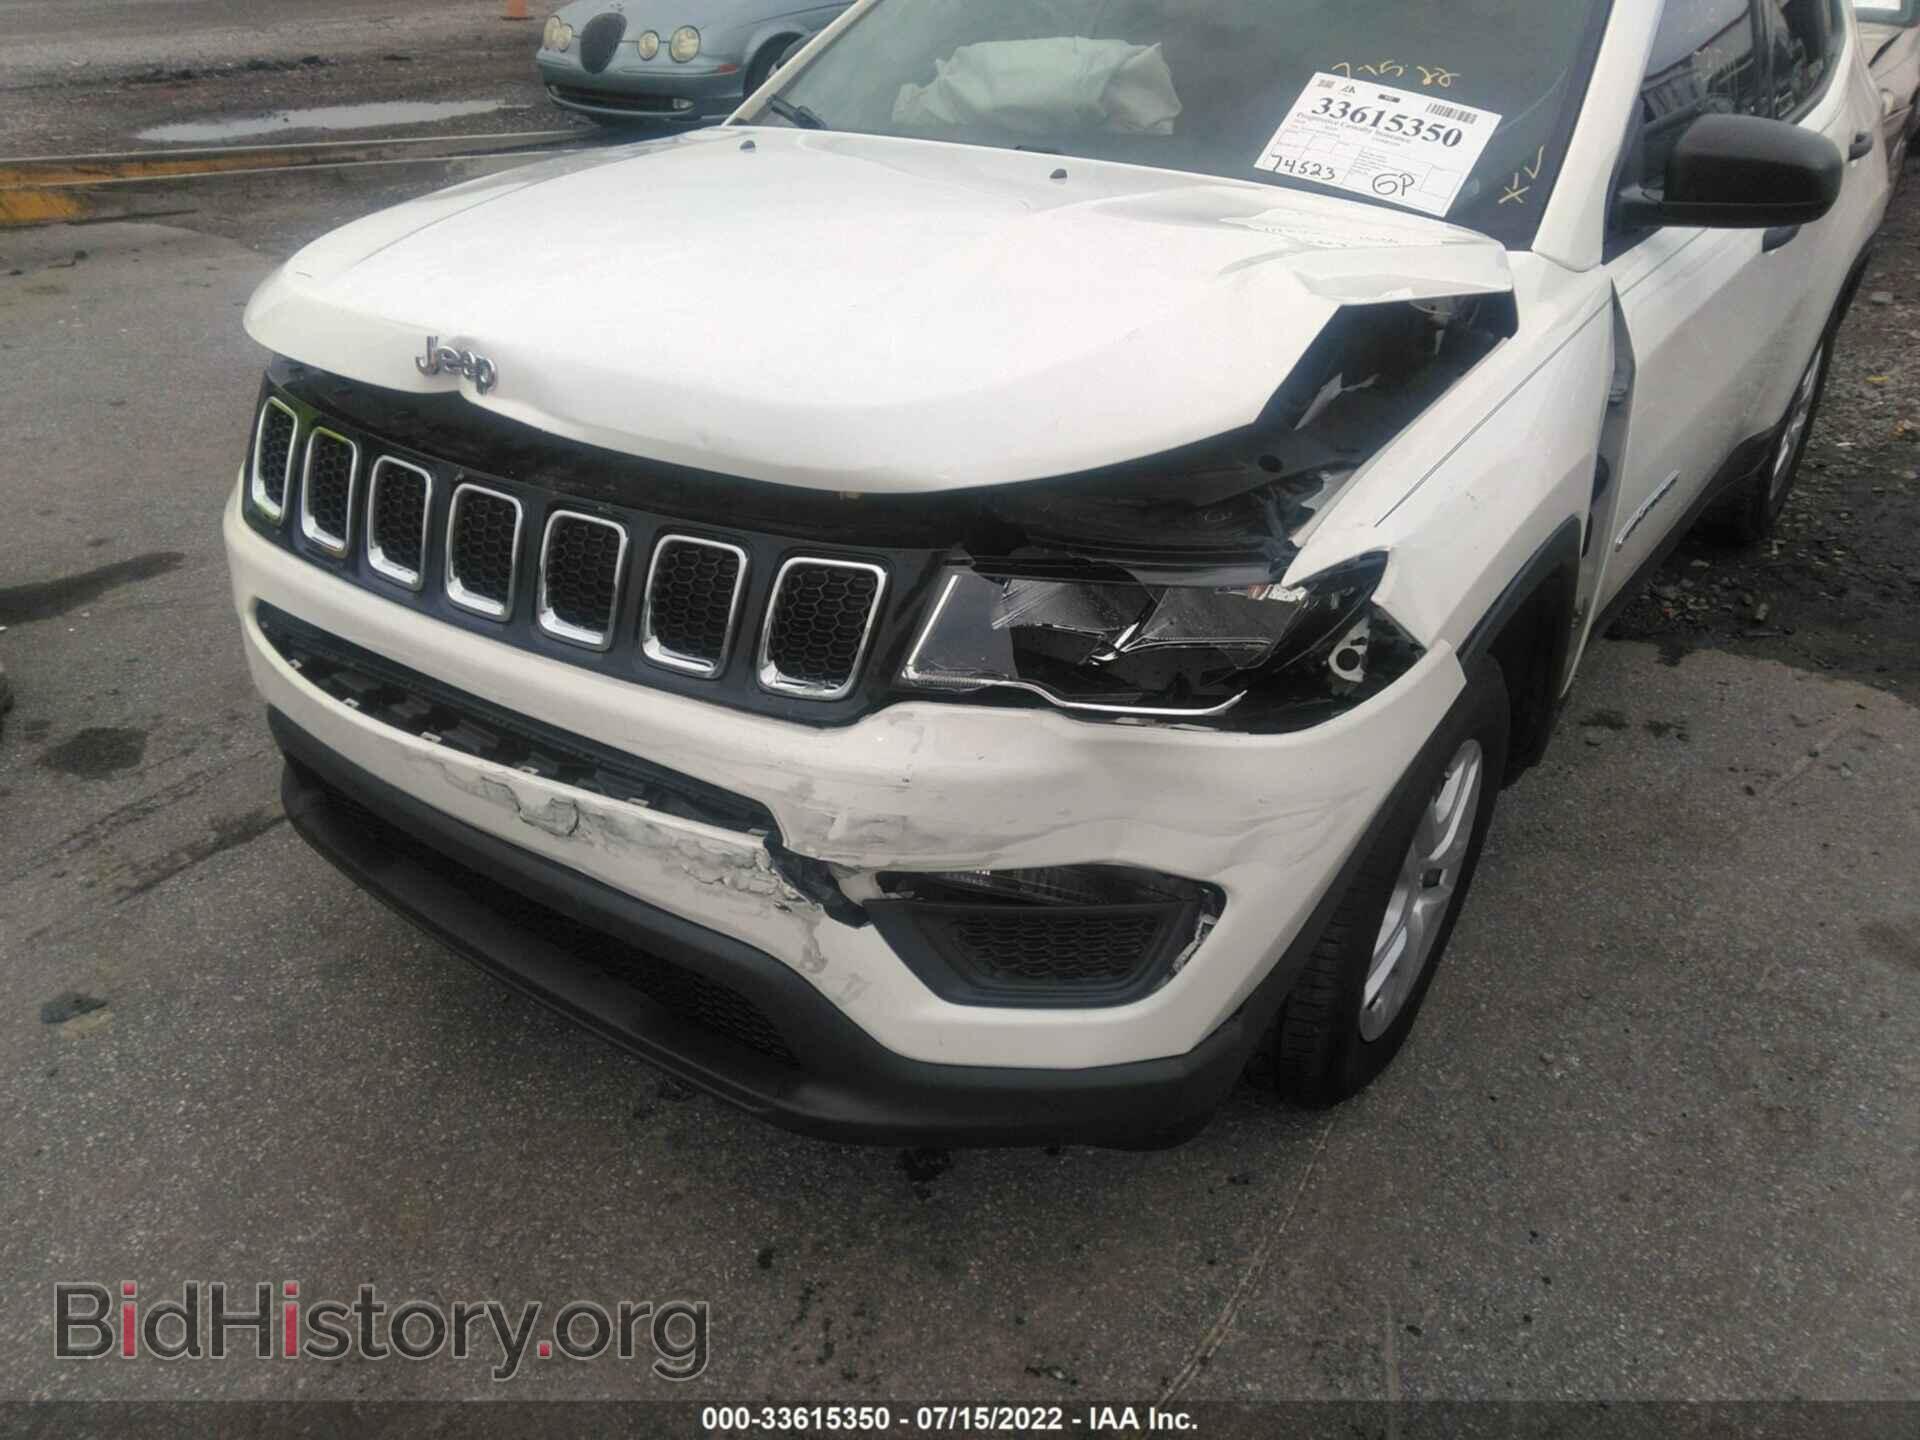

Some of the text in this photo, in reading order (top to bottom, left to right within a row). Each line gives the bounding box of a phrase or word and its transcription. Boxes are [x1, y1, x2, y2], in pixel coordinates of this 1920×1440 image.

[1311, 96, 1463, 147] 33615350
[1271, 154, 1336, 181] 74523
[415, 335, 498, 396] Jeep
